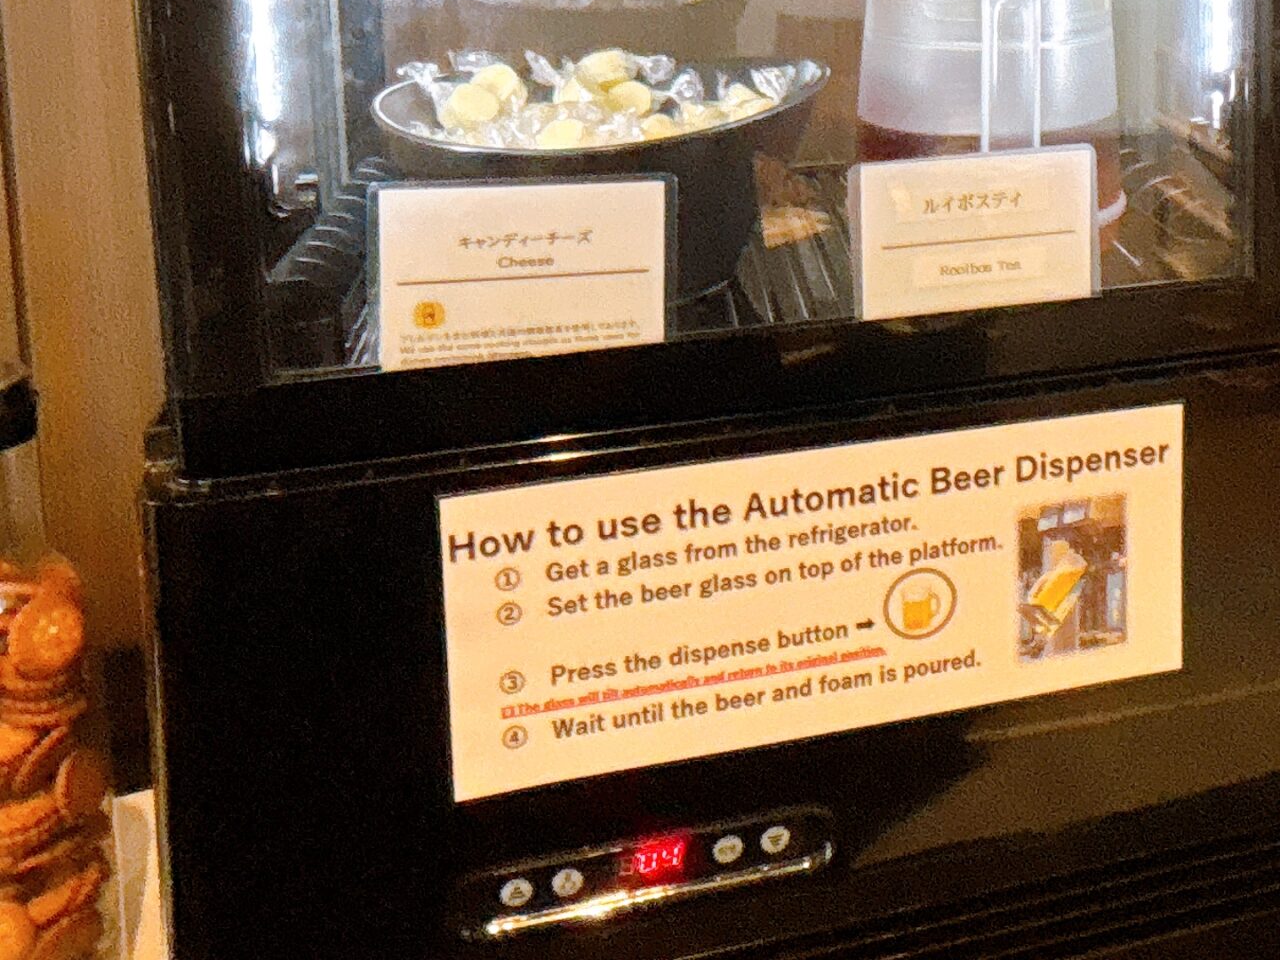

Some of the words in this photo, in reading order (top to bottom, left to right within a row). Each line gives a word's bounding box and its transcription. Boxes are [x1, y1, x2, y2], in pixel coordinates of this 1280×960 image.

[496, 255, 555, 269] Cheese
[449, 529, 535, 563] How
[546, 520, 584, 548] to
[598, 512, 662, 541] use
[672, 498, 731, 531] the
[743, 471, 920, 521] Automatic
[931, 463, 1005, 496] Beer
[1015, 442, 1171, 484] Dispenser
[545, 558, 590, 583] Get
[595, 561, 610, 576] a
[617, 550, 678, 578] glass
[684, 539, 738, 565] from
[745, 533, 782, 555] the
[788, 514, 918, 549] refrigerator.
[547, 593, 588, 618] Set
[594, 588, 633, 610] the
[640, 580, 692, 604] beer
[699, 568, 758, 599] glass
[764, 565, 792, 585] on
[798, 555, 835, 583] top
[840, 549, 863, 572] of
[868, 544, 903, 569] the
[909, 534, 1004, 568] platform.
[551, 661, 618, 687] Press
[623, 652, 662, 673] the
[669, 637, 771, 667] dispense
[777, 623, 849, 650] button
[551, 712, 606, 740] Wait
[612, 703, 664, 730] until
[670, 697, 709, 720] the
[715, 689, 767, 712] beer
[771, 677, 813, 703] and
[818, 669, 873, 694] foam
[879, 664, 898, 684] is
[903, 648, 982, 683] poured.
